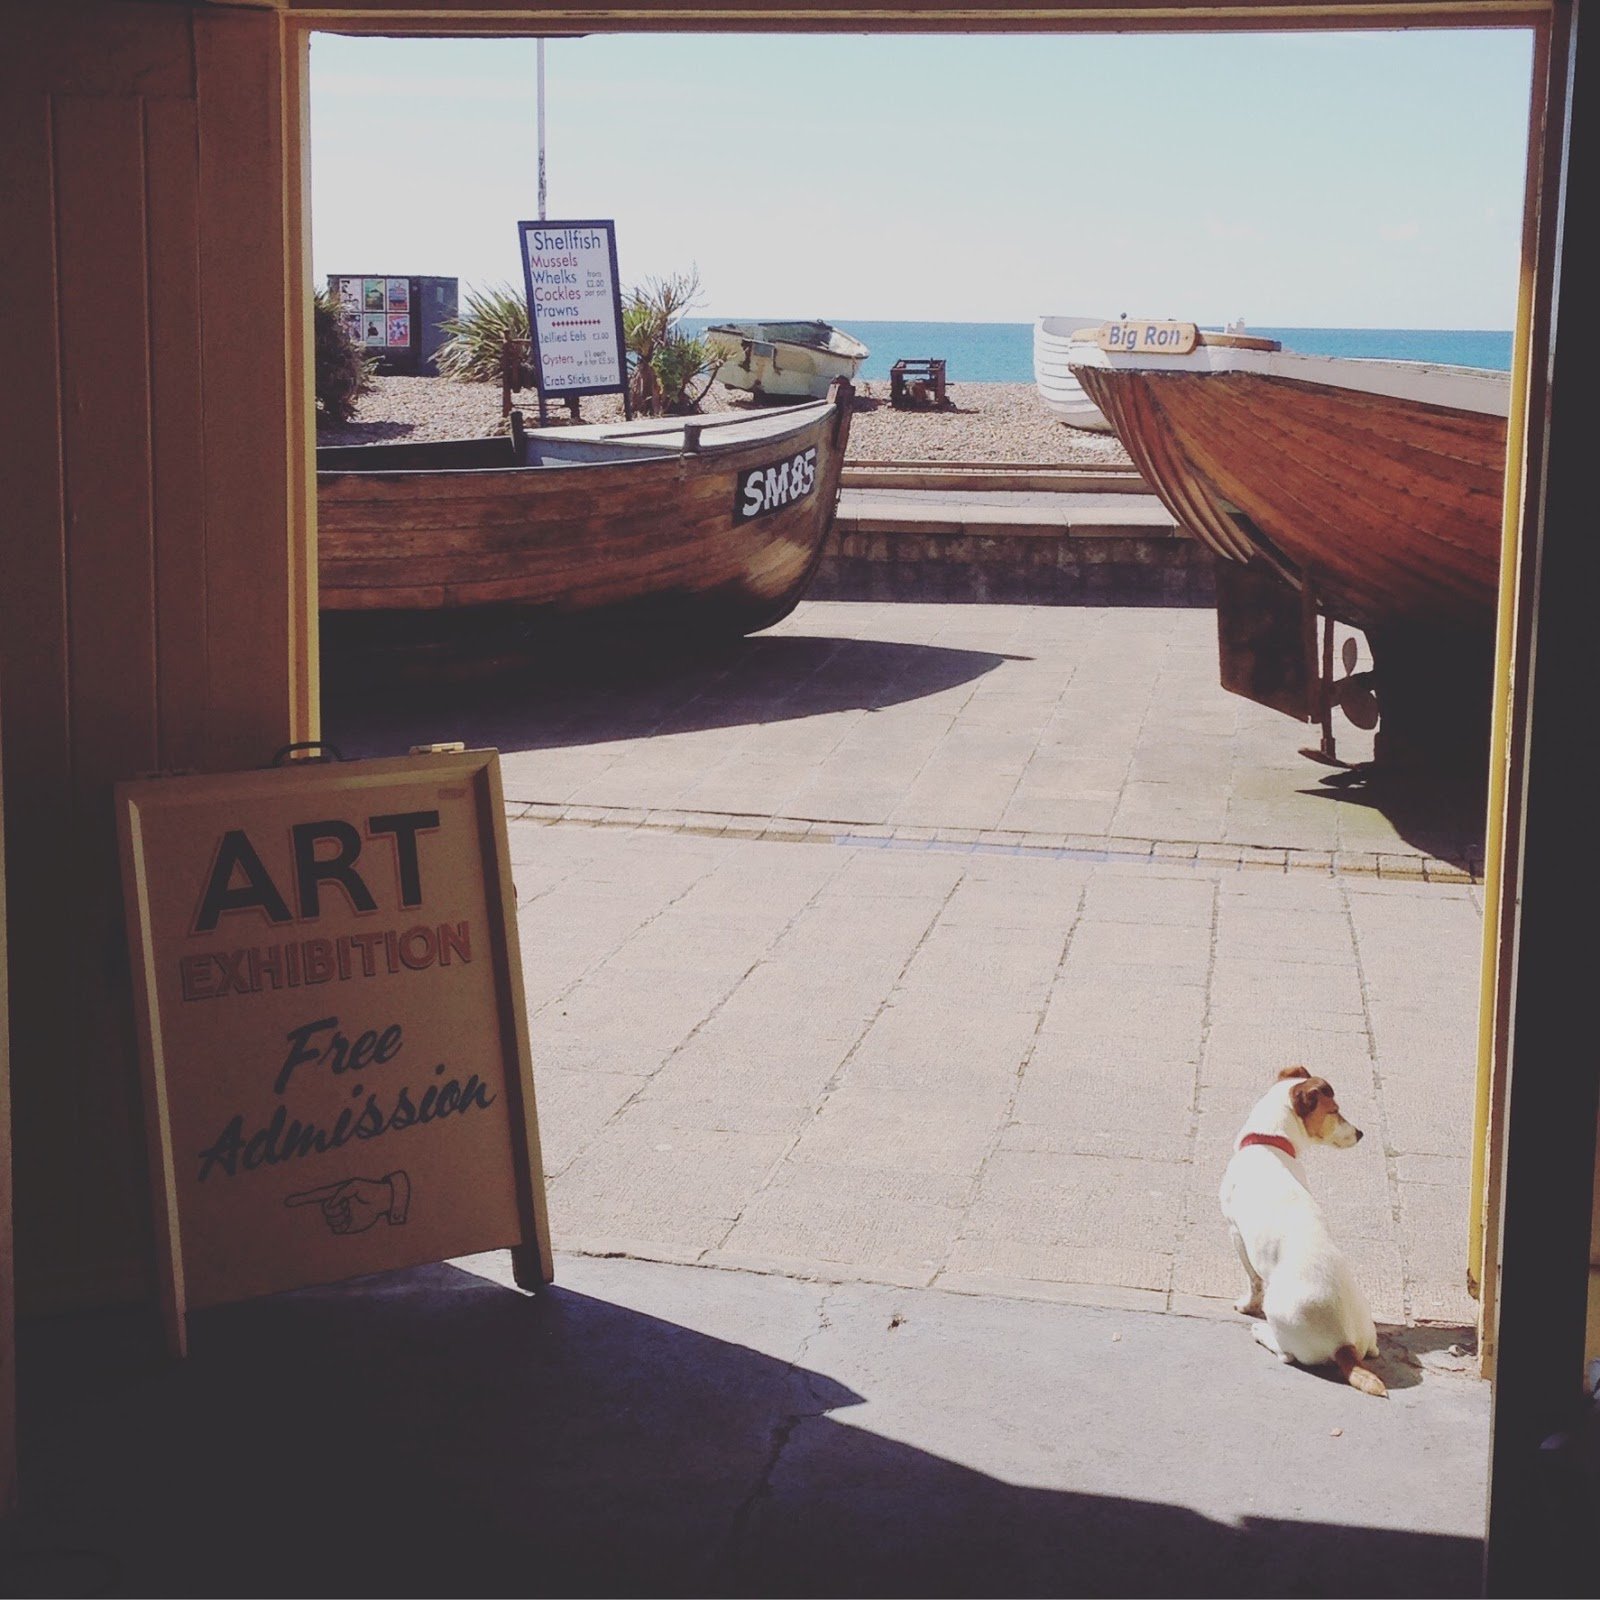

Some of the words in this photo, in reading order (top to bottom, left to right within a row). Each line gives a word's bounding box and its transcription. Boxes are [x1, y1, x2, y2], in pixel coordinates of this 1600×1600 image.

[534, 230, 600, 250] Shellfish
[531, 252, 578, 268] Mussels
[532, 269, 577, 284] Whelks
[534, 285, 581, 301] Cockles
[536, 303, 579, 317] Prawns
[540, 331, 568, 343] Jellied
[570, 330, 587, 342] Eels
[1108, 326, 1138, 349] Big
[1143, 328, 1181, 346] Ron
[542, 353, 574, 366] Oysters
[544, 376, 565, 387] Crab
[567, 374, 591, 385] Sticks
[742, 448, 816, 517] SM85
[192, 810, 440, 934] ART
[179, 921, 472, 1001] EXHIBITION
[273, 1016, 403, 1095] Free
[198, 1064, 497, 1182] Admission
